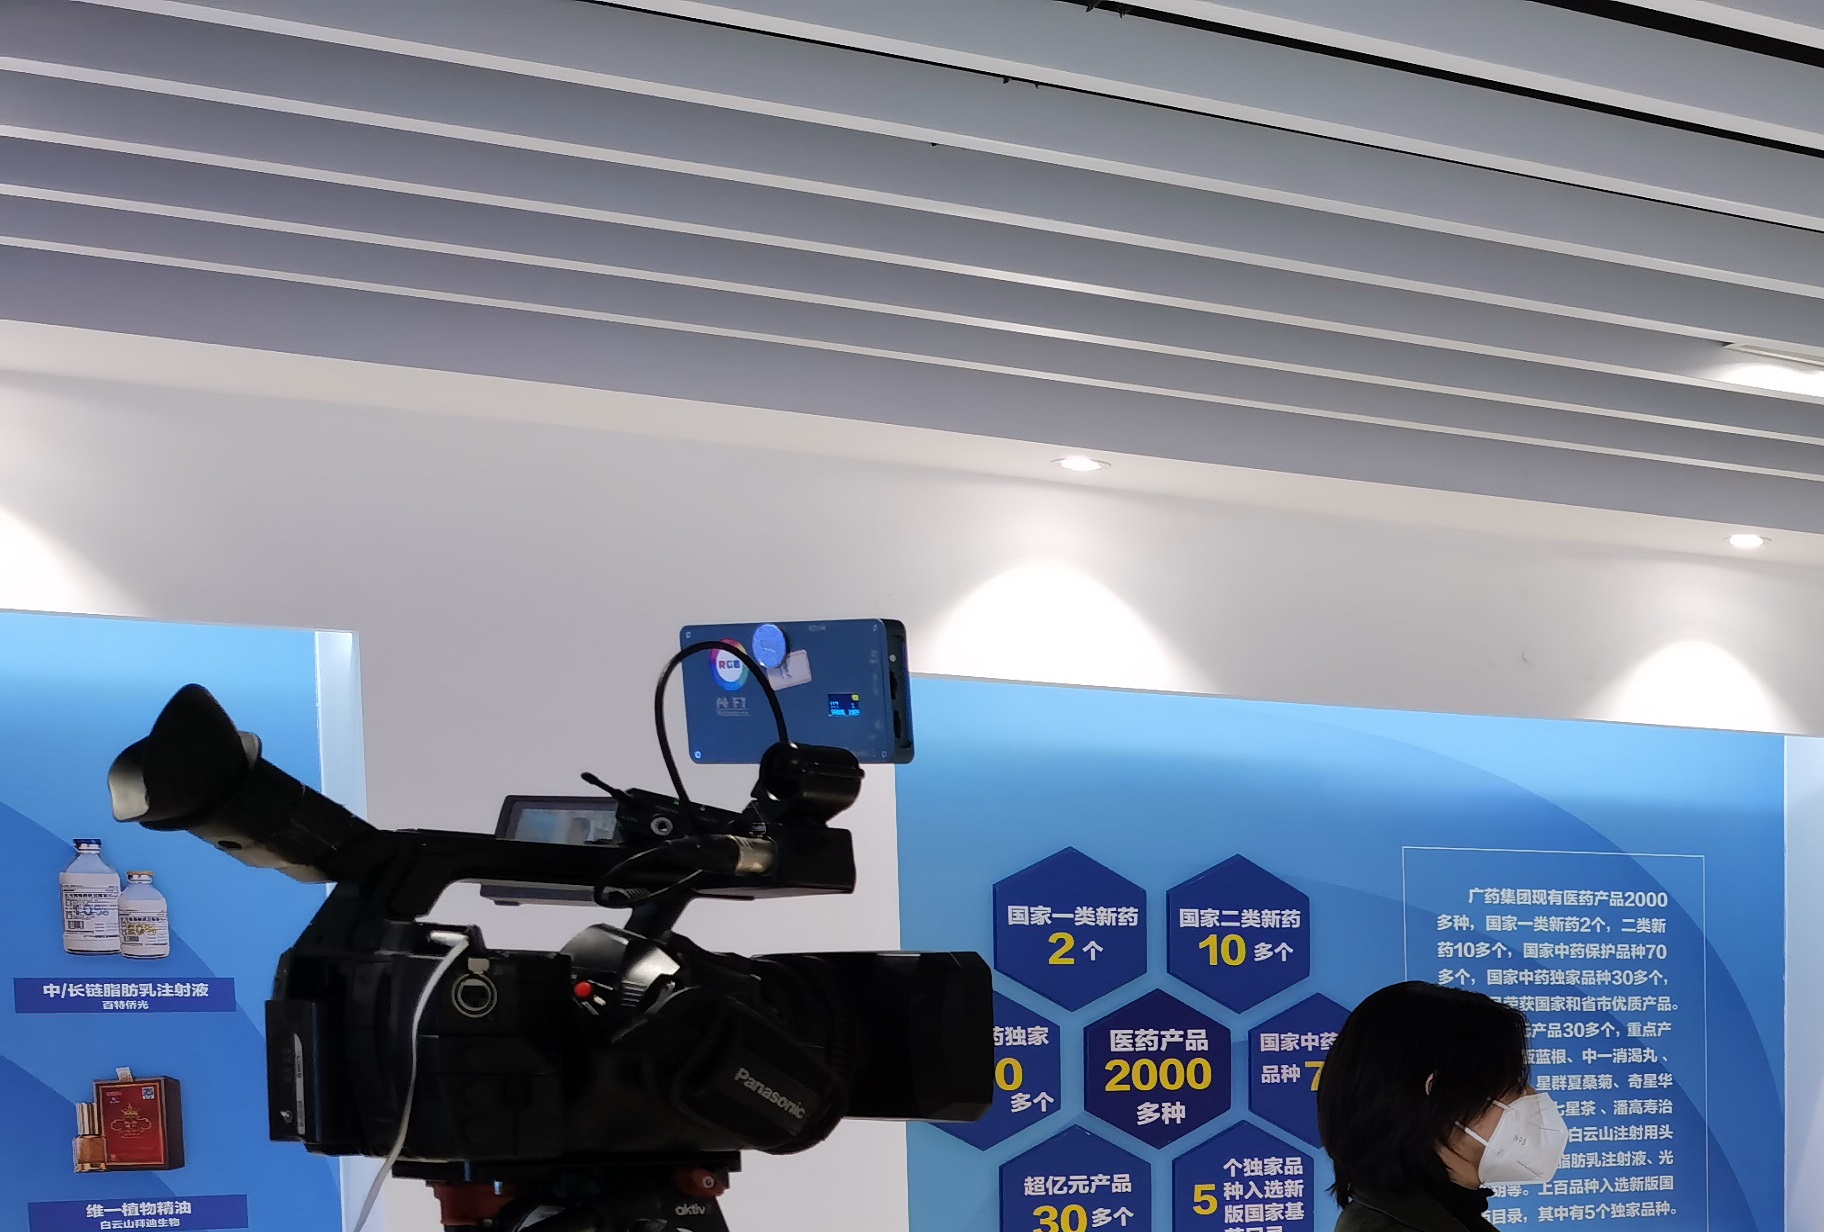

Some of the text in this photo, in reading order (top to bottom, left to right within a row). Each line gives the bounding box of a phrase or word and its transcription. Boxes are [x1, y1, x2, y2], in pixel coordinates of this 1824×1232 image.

[719, 660, 740, 669] RGB
[1468, 887, 1668, 908] 广药集团现有医药产品2000
[1007, 905, 1138, 926] 国家一类新药
[1179, 908, 1301, 928] 国家二类新药
[1436, 915, 1666, 933] 多种，国家一类新药2个，二类新
[1047, 932, 1103, 965] 2 个
[1198, 934, 1293, 966] 10 多个
[1437, 942, 1667, 960] 药10多个，国家中药保护品种70
[1438, 969, 1669, 986] 多个，国家中药独家品种30多个，
[43, 982, 209, 998] 中/长链脂肪乳注射液
[102, 999, 149, 1010] 百特侨光
[1109, 1029, 1209, 1052] 医药产品
[1104, 1058, 1212, 1092] 2000
[1261, 1065, 1300, 1084] 品种
[1536, 1073, 1673, 1091] 星群夏桑菊、奇星华
[734, 1066, 806, 1120] Panasonic
[1010, 1092, 1054, 1113] 多个
[1136, 1102, 1186, 1125] 多种
[1569, 1124, 1673, 1142] 白云山注射用头
[1223, 1156, 1303, 1177] 个独家品
[1023, 1173, 1132, 1197] 超亿元产品
[1223, 1179, 1304, 1200] 种入选新
[86, 1201, 192, 1218] 维一植物精油
[675, 1203, 706, 1216] aktiv
[1192, 1183, 1218, 1215] 5
[1091, 1207, 1134, 1228] 多个
[1224, 1201, 1304, 1224] 版国家基
[100, 1217, 180, 1230] 白云山拜迪生物
